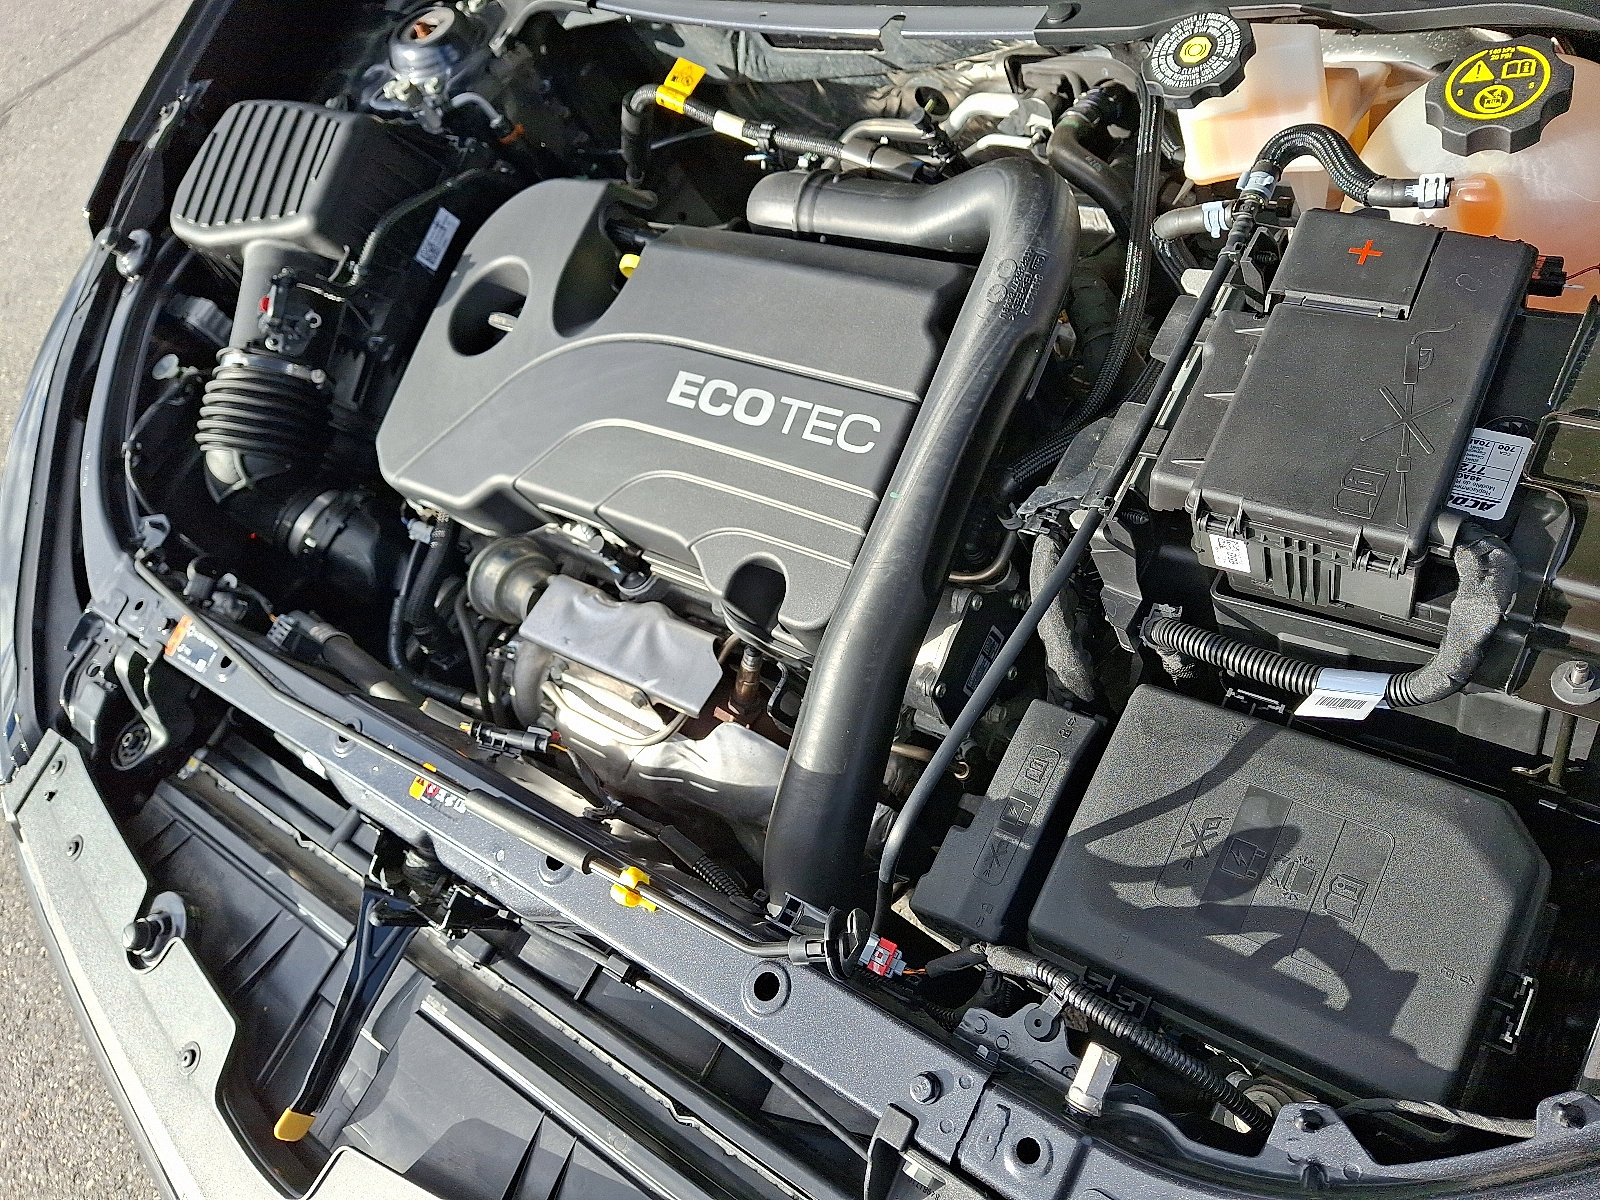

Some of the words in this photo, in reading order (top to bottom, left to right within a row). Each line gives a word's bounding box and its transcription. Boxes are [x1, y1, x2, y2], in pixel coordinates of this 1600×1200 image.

[666, 370, 881, 454] ECOTEC
[1498, 444, 1516, 453] 700
[1460, 462, 1486, 476] 772
[1450, 494, 1497, 511] ACD
